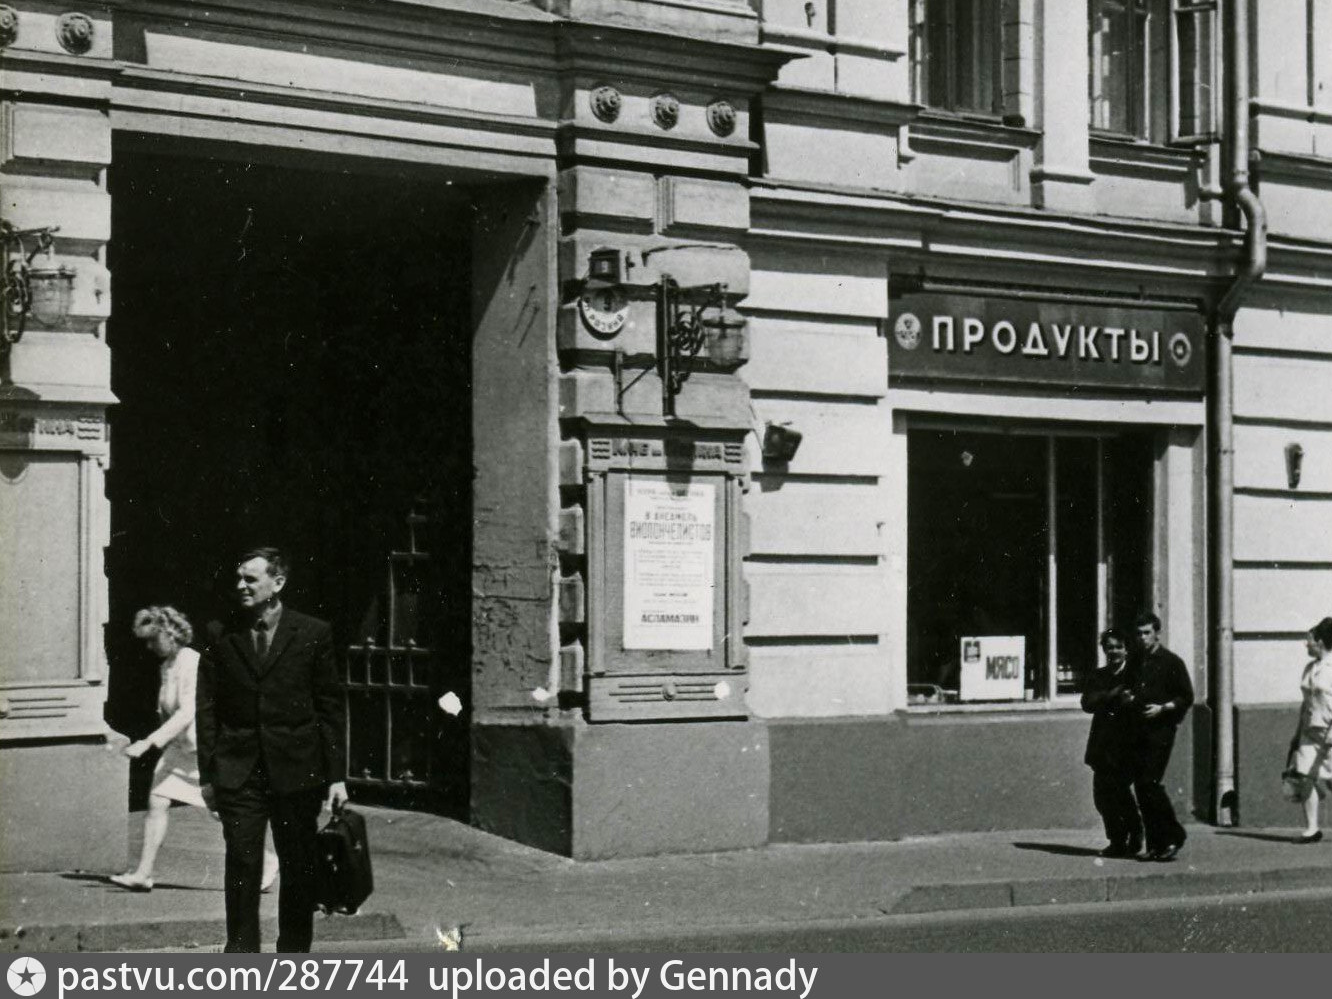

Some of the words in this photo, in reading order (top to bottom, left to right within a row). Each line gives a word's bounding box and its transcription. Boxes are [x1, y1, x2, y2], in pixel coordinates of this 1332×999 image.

[932, 315, 1160, 362] ПРОДУКТЫ
[630, 521, 712, 541] ВИОЛОНЧЕЛИСТОВ
[985, 655, 1020, 680] МЯСО
